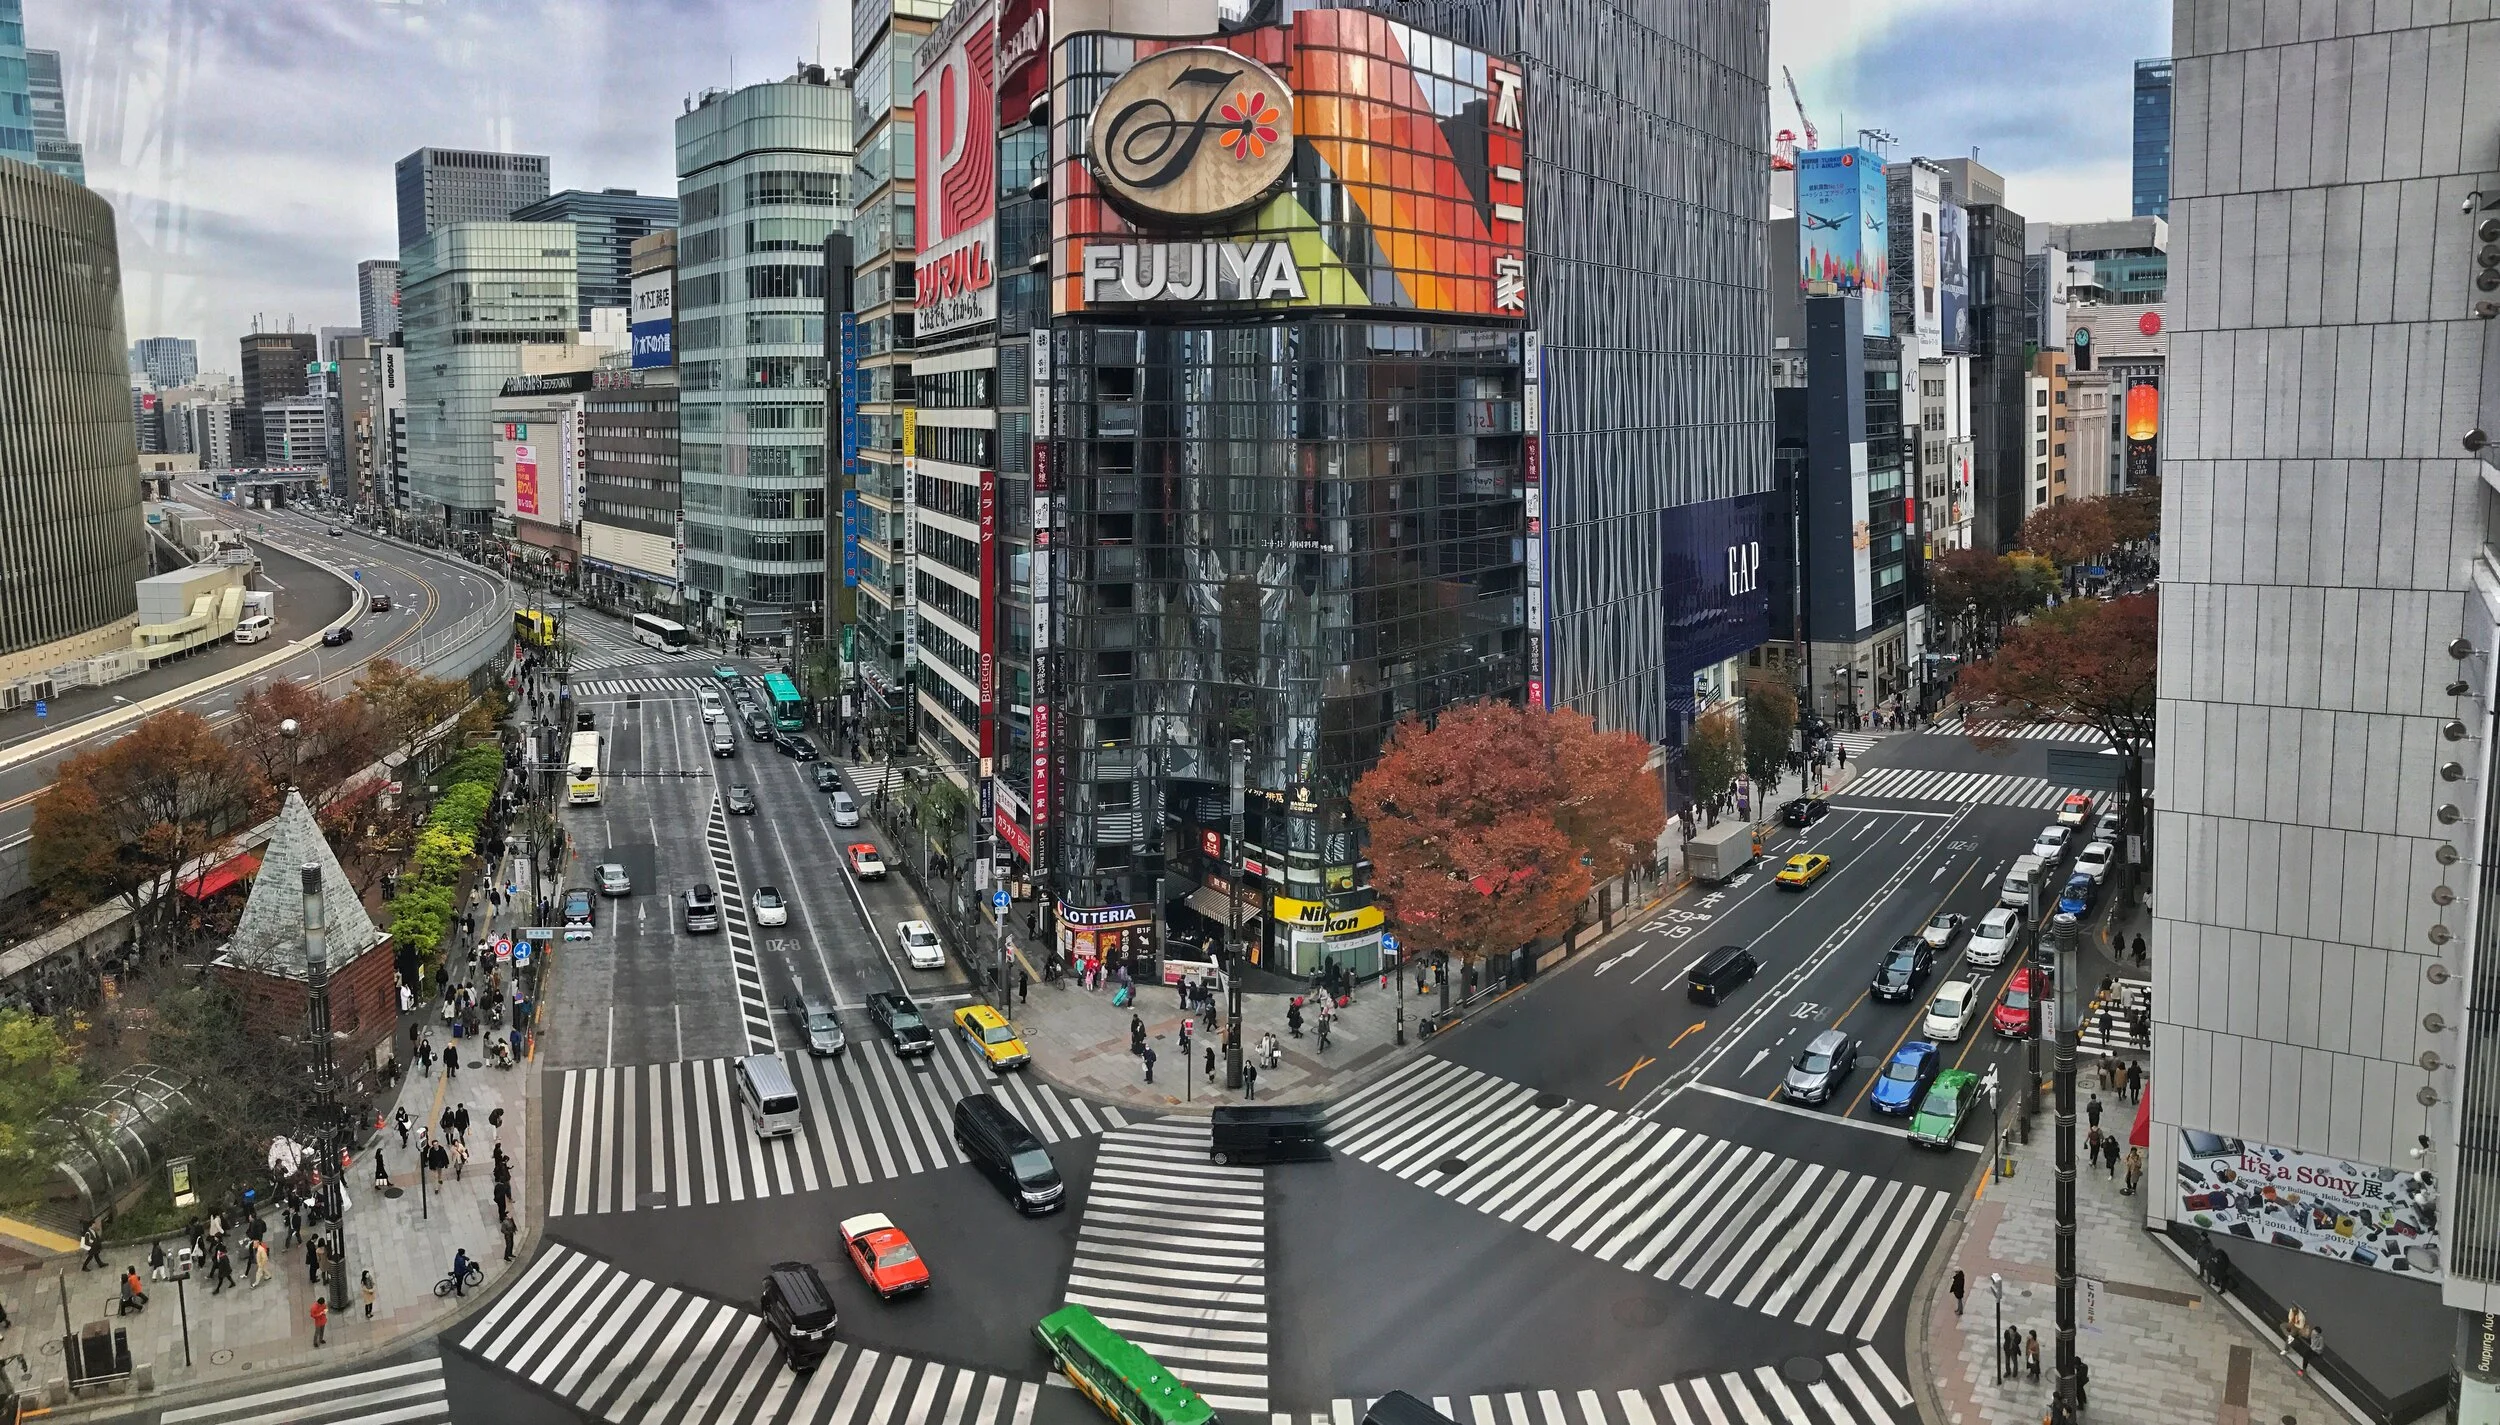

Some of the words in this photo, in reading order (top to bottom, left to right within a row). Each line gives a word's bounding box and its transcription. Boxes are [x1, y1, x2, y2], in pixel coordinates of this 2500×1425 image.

[1494, 69, 1525, 311] 不二家
[1083, 241, 1307, 301] FUJIYA
[639, 288, 670, 311] 木下工務店
[639, 334, 671, 355] 木下の介護
[387, 353, 395, 388] JOYSOUND
[982, 481, 992, 541] カラオケ
[1728, 541, 1759, 596] GAP
[1037, 769, 1045, 808] 不二家
[998, 815, 1016, 840] カラオケ
[1064, 907, 1136, 924] LOTTERIA
[1300, 906, 1359, 932] Nikon
[1637, 920, 1693, 939] 17-19
[766, 938, 801, 952] 8-20
[2238, 1154, 2271, 1175] It's
[2277, 1166, 2291, 1180] a
[2297, 1166, 2361, 1199] Sony
[2361, 1178, 2383, 1200] 展
[2321, 1193, 2341, 1203] Hello
[2265, 1220, 2310, 1235] 2016.11.12
[2482, 1312, 2495, 1331] ony
[2478, 1332, 2495, 1372] Building
